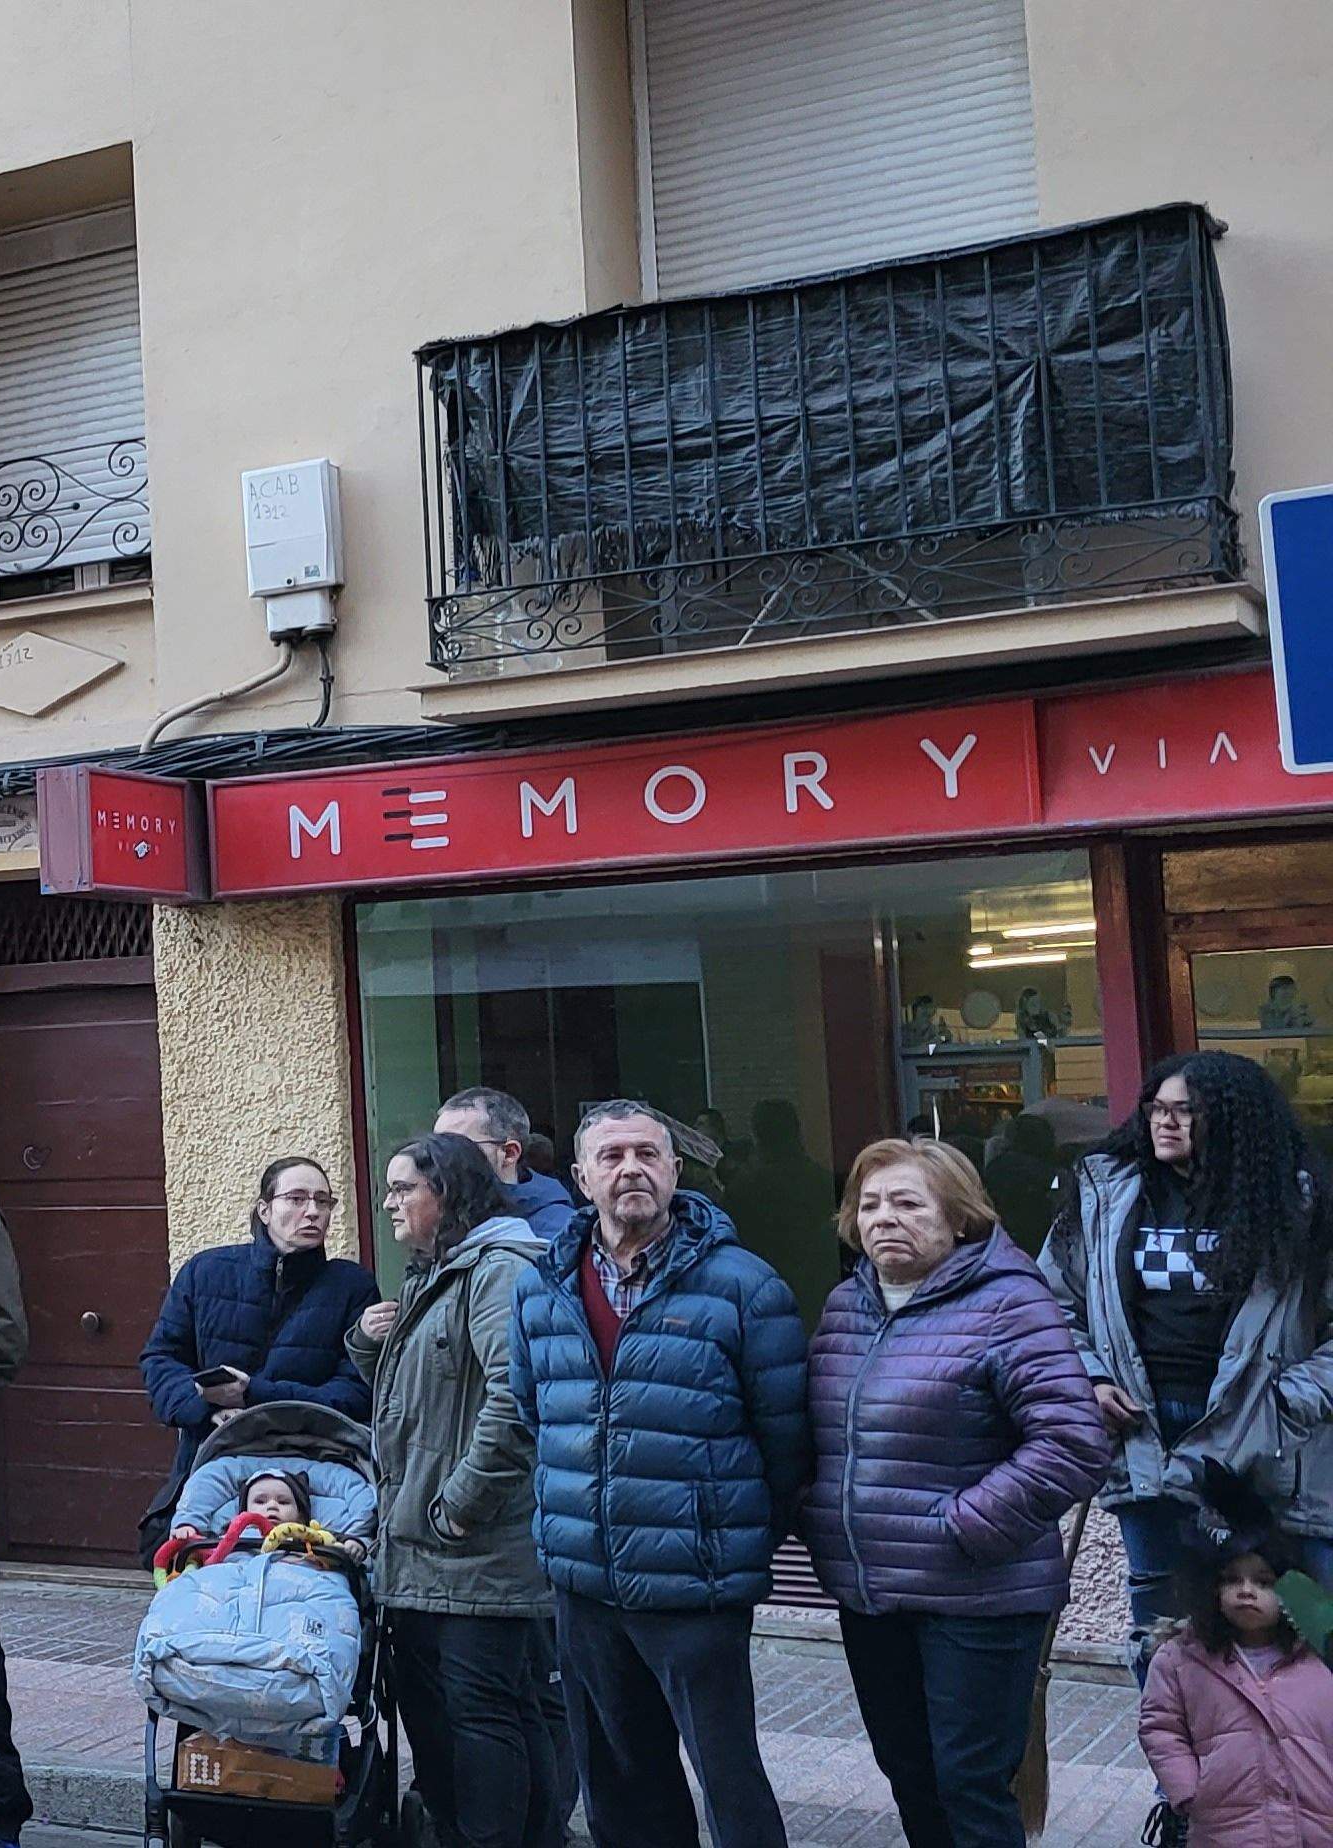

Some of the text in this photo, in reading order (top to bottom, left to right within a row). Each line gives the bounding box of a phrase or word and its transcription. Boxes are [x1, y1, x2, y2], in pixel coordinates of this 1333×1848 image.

[253, 502, 291, 520] 1312
[1088, 731, 1281, 775] VIA
[289, 734, 977, 859] MEMORY
[97, 809, 176, 835] MEMORY
